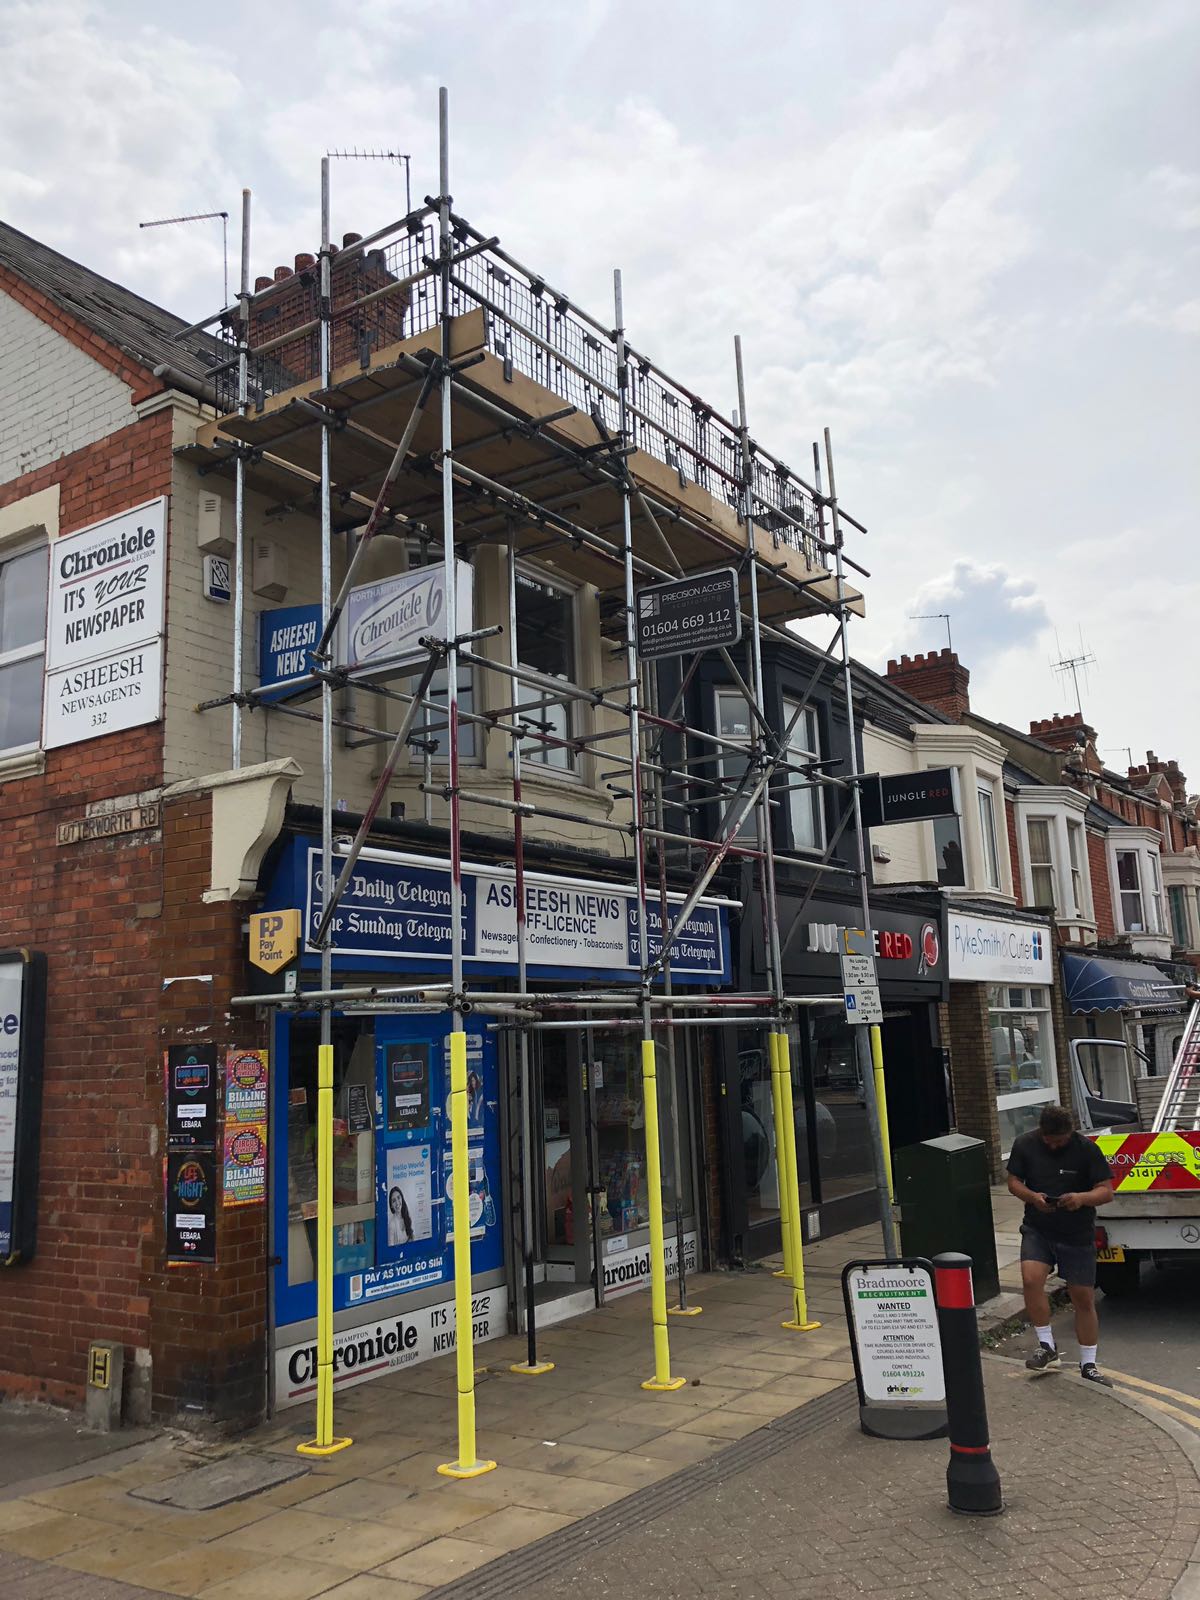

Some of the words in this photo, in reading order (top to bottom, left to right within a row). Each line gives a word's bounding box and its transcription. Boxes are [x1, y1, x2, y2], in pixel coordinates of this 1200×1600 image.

[60, 526, 156, 579] Chronicle
[64, 586, 86, 614] IT'S
[94, 564, 149, 601] YOUR
[662, 586, 701, 603] PRECISION
[702, 580, 732, 595] ACCESS
[65, 598, 145, 645] NEWSPAPER
[360, 592, 422, 646] Chronicle
[642, 619, 679, 637] 01604
[682, 613, 705, 629] 669
[708, 608, 731, 625] 112
[269, 620, 317, 654] ASHEESH
[276, 649, 307, 678] NEWS
[60, 654, 144, 698] ASHEESH
[61, 681, 142, 716] NEWSAGENTS
[91, 712, 108, 727] 332
[887, 791, 927, 804] JUNGLE
[928, 788, 949, 798] RED
[58, 811, 132, 843] LUTTERWORTH
[140, 808, 156, 827] RD
[351, 876, 395, 905] Daily
[398, 880, 468, 908] Telegrah
[575, 894, 620, 920] NEWS
[346, 912, 404, 939] Sunday
[406, 919, 467, 942] Telegrah
[522, 912, 597, 935] FF-LICENCE
[259, 939, 275, 952] Pay
[529, 933, 578, 949] Confectionery
[584, 937, 624, 951] Tobacconists
[806, 922, 880, 958] JUE
[882, 931, 913, 959] RED
[259, 949, 283, 961] Point
[681, 943, 716, 961] Telegraph
[227, 1100, 267, 1110] AQUADROME
[228, 1090, 267, 1102] BILLING
[399, 1108, 418, 1116] LEBARA
[181, 1120, 202, 1128] LEBARA
[393, 1163, 407, 1171] Hello
[407, 1160, 425, 1169] World
[1137, 1150, 1187, 1164] ACCESS
[225, 1176, 265, 1188] AQUADROME
[226, 1166, 265, 1181] BILLING
[392, 1171, 408, 1179] Hello
[408, 1169, 425, 1177] Home
[179, 1231, 201, 1240] LEBARA
[364, 1271, 381, 1284] PAY
[382, 1268, 394, 1280] AS
[395, 1263, 413, 1277] YOU
[414, 1261, 427, 1272] GO
[428, 1256, 443, 1268] SIM
[857, 1277, 926, 1289] Bradmoore
[863, 1290, 921, 1298] RECRUITMENT
[877, 1302, 911, 1310] WANTED
[430, 1308, 447, 1329] IT'S
[92, 1351, 108, 1385] H
